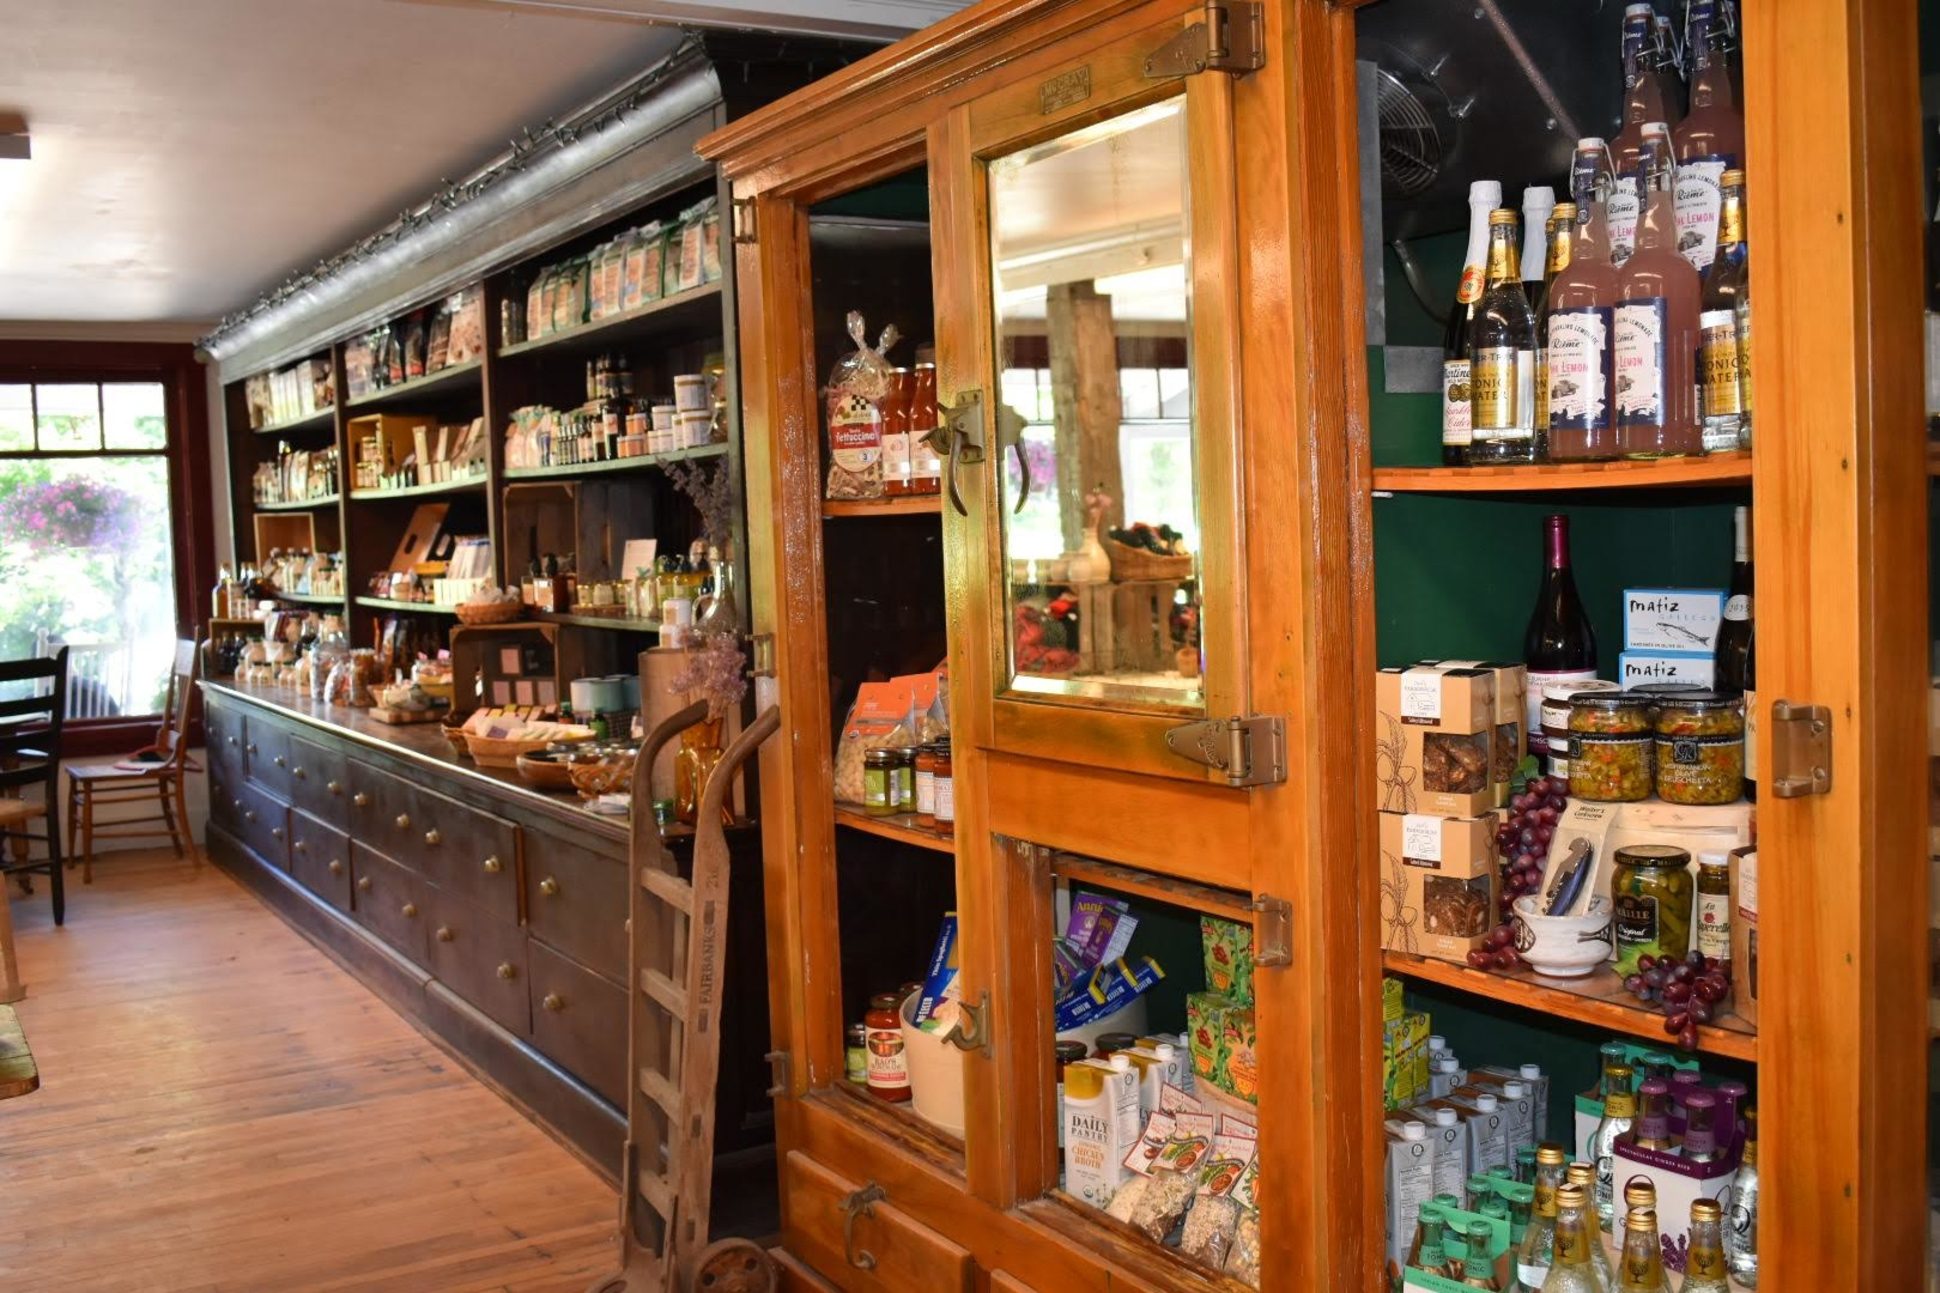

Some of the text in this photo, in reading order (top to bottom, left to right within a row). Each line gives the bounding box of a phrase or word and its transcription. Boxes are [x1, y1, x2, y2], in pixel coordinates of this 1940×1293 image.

[1687, 211, 1715, 224] LEMON
[1561, 361, 1589, 373] LEMON
[1619, 356, 1643, 368] LEMON
[1629, 596, 1680, 613] matiz
[1625, 661, 1678, 678] matiz
[700, 926, 716, 1004] FAIRBANKS
[1072, 1114, 1109, 1134] DAILY
